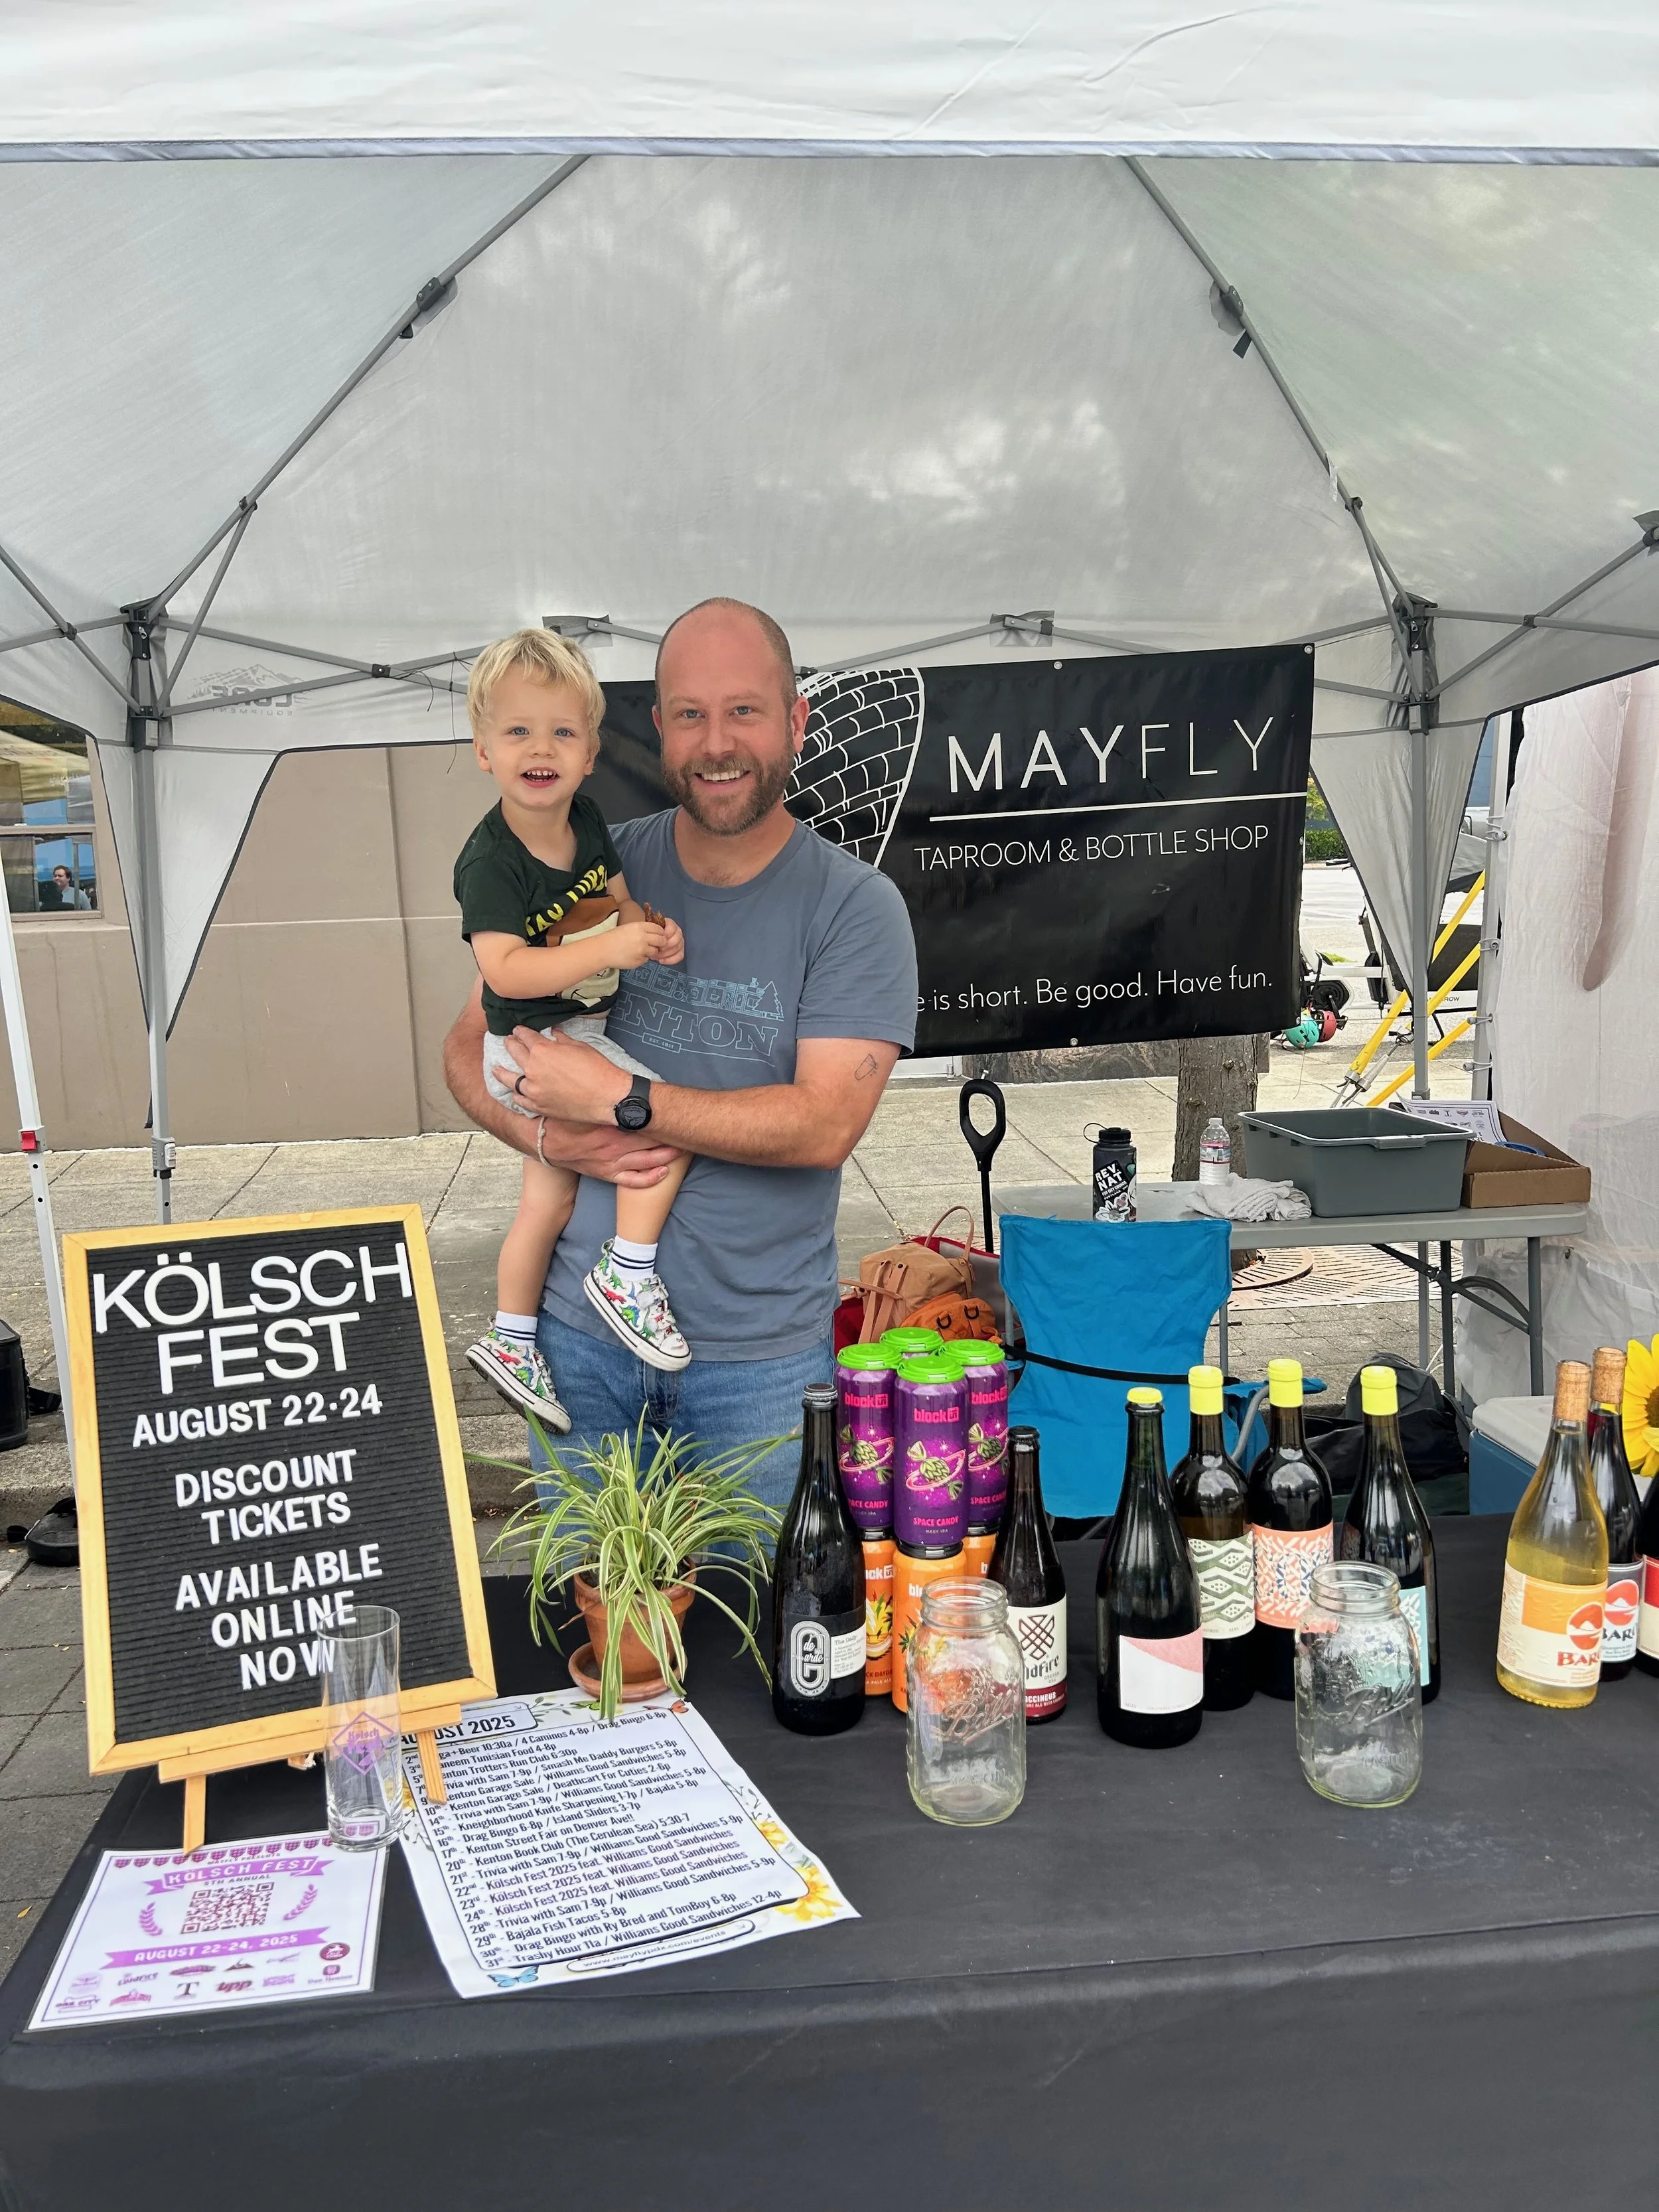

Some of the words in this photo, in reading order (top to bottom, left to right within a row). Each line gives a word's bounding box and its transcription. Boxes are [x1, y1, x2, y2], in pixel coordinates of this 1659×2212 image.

[948, 717, 1273, 792] MAYFLY
[914, 840, 1050, 871] TAPROOM
[1059, 838, 1079, 863] &
[1086, 830, 1187, 861] BOTTLE
[1195, 825, 1269, 851] SHOP
[933, 993, 950, 1011] is
[958, 987, 1027, 1009] short.
[1037, 979, 1068, 1003] Be
[1075, 972, 1149, 1007] good.
[1157, 970, 1222, 994] Have
[1228, 964, 1273, 988] fun.
[609, 990, 778, 1056] ENTON
[1096, 1163, 1119, 1181] REV.
[1098, 1171, 1122, 1191] NAT
[93, 1242, 413, 1333] KÖLSCH
[158, 1312, 360, 1394] FEST
[133, 1399, 271, 1447] AUGUST
[176, 1449, 357, 1507] DISCOUNT
[971, 1495, 991, 1505] SPACE
[202, 1492, 350, 1544] TICKETS
[865, 1499, 889, 1509] CANDY
[913, 1516, 935, 1526] SPACE
[936, 1515, 960, 1526] CANDY
[175, 1543, 383, 1611] AVAILABLE
[211, 1590, 357, 1649] ONLINE
[240, 1641, 335, 1690] NOW
[401, 1723, 465, 1745] AUUST
[468, 1715, 516, 1735] 2025
[438, 1746, 480, 1759] ga+Beer
[480, 1740, 512, 1751] 10:30a
[528, 1732, 568, 1743] Caminos
[595, 1719, 621, 1730] Drag
[618, 1716, 646, 1725] Bingo
[439, 1758, 470, 1768] aneem
[469, 1751, 511, 1763] Tunisian
[511, 1745, 534, 1757] Food
[443, 1781, 464, 1789] rivia
[464, 1775, 487, 1786] with
[487, 1773, 510, 1782] Sam
[540, 1758, 573, 1771] Smash
[588, 1749, 618, 1761] Daddy
[618, 1743, 656, 1755] Burgers
[449, 1799, 486, 1811] Kenton
[486, 1792, 522, 1803] Garage
[522, 1786, 544, 1796] Sale
[552, 1774, 601, 1789] Deathcart
[616, 1767, 648, 1777] Cuties
[457, 1809, 534, 1831] Kneighborhood
[534, 1805, 561, 1816] Knife
[561, 1794, 618, 1810] Sharpening
[645, 1783, 676, 1795] Bajala
[462, 1832, 489, 1842] Drag
[488, 1826, 518, 1838] Bingo
[551, 1810, 583, 1824] Island
[583, 1806, 618, 1817] Sliders
[465, 1842, 504, 1854] Kenton
[504, 1833, 538, 1847] Street
[538, 1829, 557, 1840] Fair
[559, 1826, 573, 1835] on
[573, 1819, 608, 1832] Denver
[609, 1813, 634, 1825] Ave!!
[474, 1853, 513, 1866] Kenton
[513, 1845, 541, 1858] Book
[540, 1840, 564, 1852] Club
[565, 1836, 589, 1848] (The
[589, 1827, 634, 1841] Cerulean
[634, 1820, 658, 1832] Sea)
[169, 1864, 250, 1884] KÖLSCH
[261, 1858, 315, 1872] FEST
[229, 1874, 271, 1883] ANNUAL
[485, 1875, 523, 1890] Kölsch
[523, 1870, 548, 1881] Fest
[547, 1862, 577, 1876] 2025
[601, 1848, 648, 1863] Williams
[647, 1840, 674, 1853] Good
[673, 1830, 733, 1847] Sandwiches
[135, 1946, 197, 1962] AUGUST
[260, 1934, 298, 1947] 2025
[505, 1926, 541, 1941] Bajala
[541, 1919, 567, 1933] Fish
[565, 1913, 600, 1926] Tacos
[514, 1940, 544, 1952] Drag
[542, 1933, 576, 1945] Bingo
[577, 1925, 603, 1937] with
[646, 1908, 668, 1921] and
[666, 1899, 711, 1915] TomBoy
